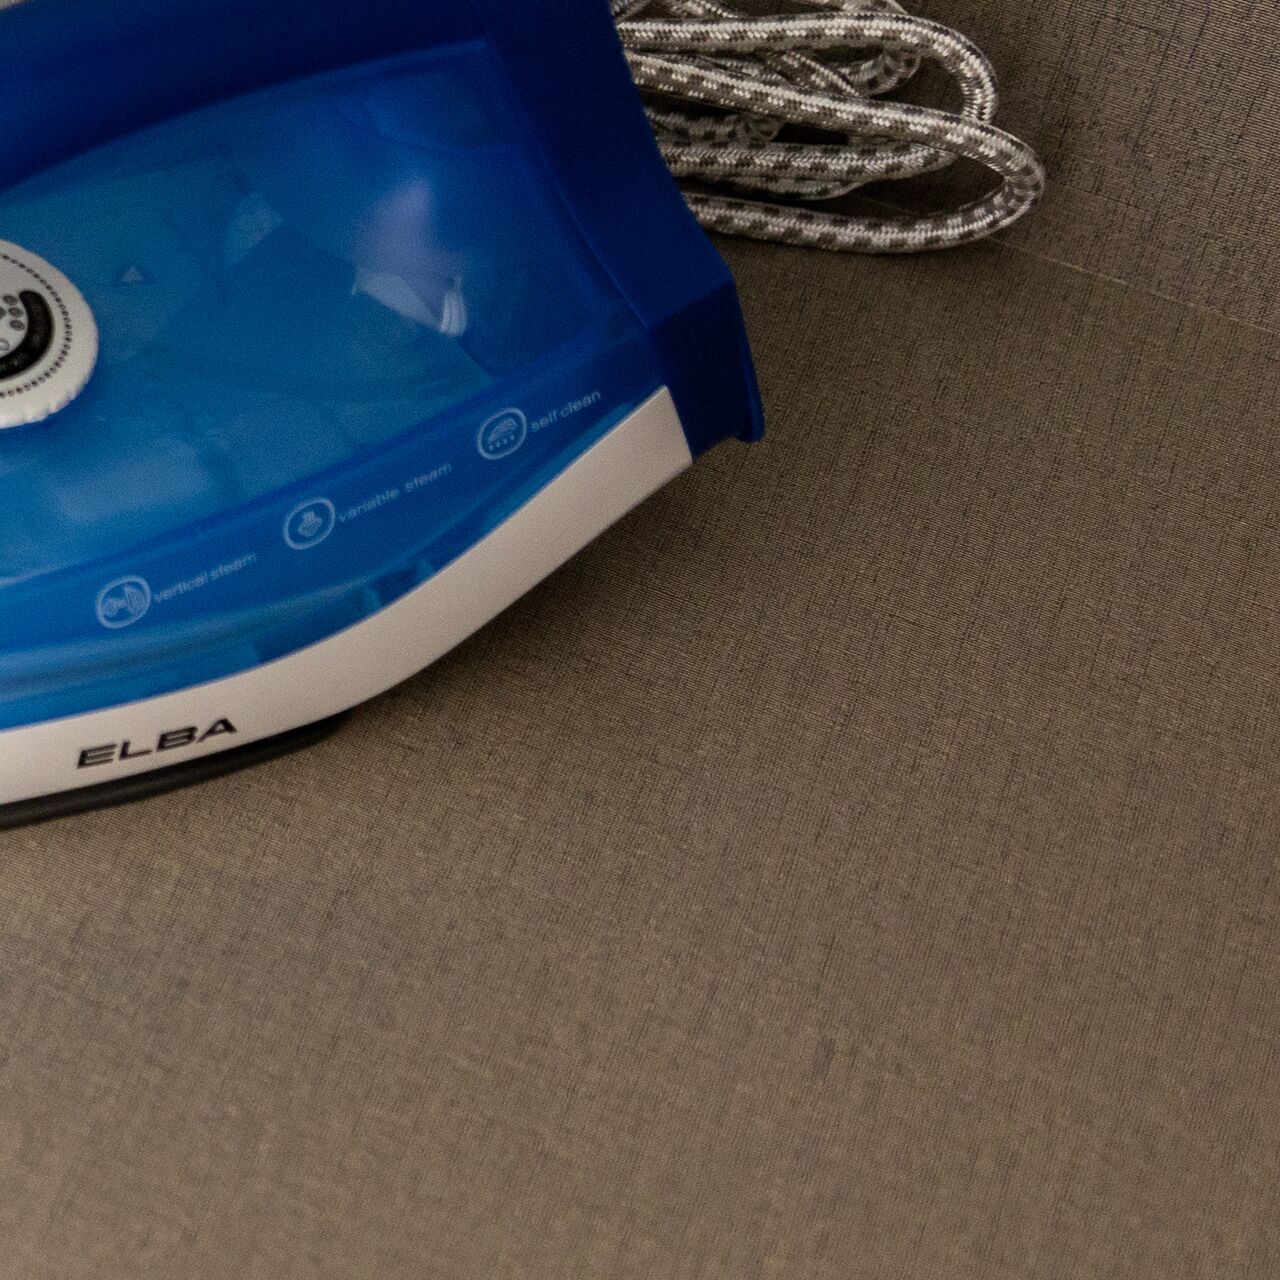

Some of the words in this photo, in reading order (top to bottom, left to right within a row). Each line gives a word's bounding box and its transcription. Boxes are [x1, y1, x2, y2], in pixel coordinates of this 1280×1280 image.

[531, 410, 557, 432] self
[560, 391, 602, 418] clean
[339, 489, 399, 522] variable
[406, 462, 452, 492] steam
[153, 570, 208, 603] vertical
[210, 553, 256, 580] steam
[77, 718, 238, 770] ELBA
